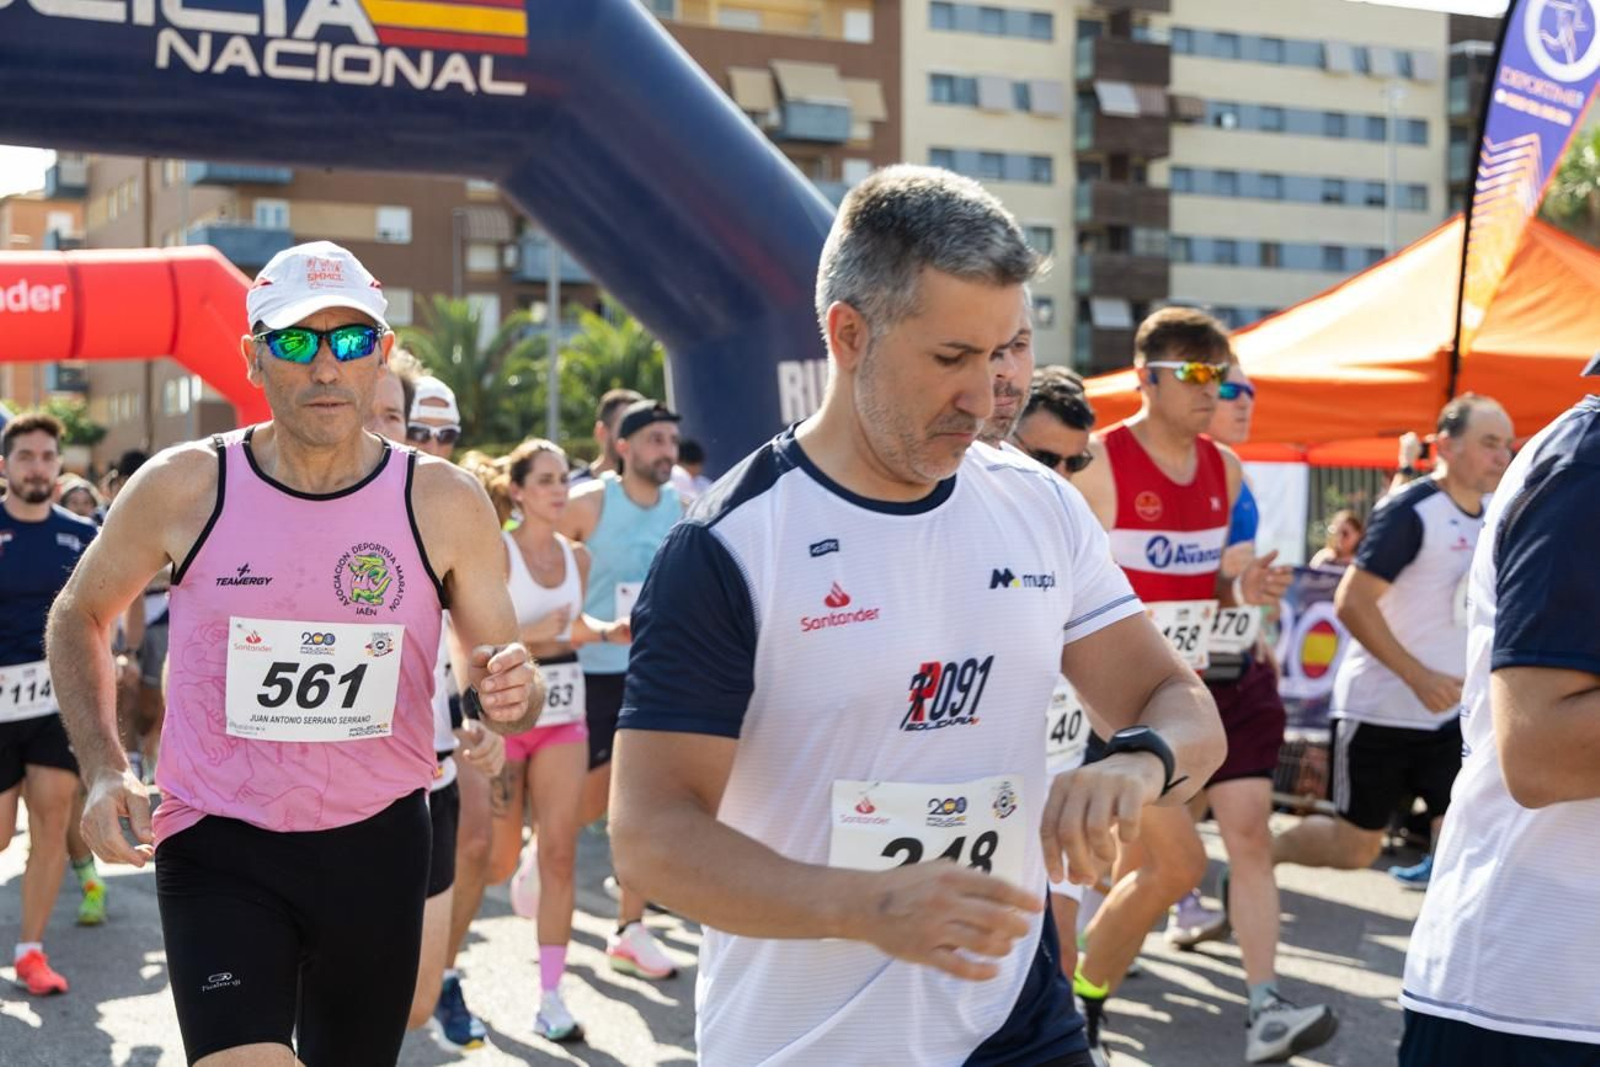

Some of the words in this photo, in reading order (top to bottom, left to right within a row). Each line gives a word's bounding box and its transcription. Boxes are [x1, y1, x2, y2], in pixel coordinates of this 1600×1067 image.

[156, 27, 527, 96] NACIONAL
[0, 278, 67, 313] der
[216, 577, 273, 586] TEAMERGY
[333, 550, 351, 607] ASOCIACION
[351, 542, 397, 565] DEPORTIVA
[389, 564, 405, 612] MARATON
[800, 607, 880, 632] Santander
[257, 662, 368, 709] 561
[250, 714, 269, 722] JUAN
[269, 715, 302, 725] ANTONIO
[303, 716, 338, 725] SERRANO
[339, 715, 371, 724] SERRANO
[1050, 709, 1082, 744] 40
